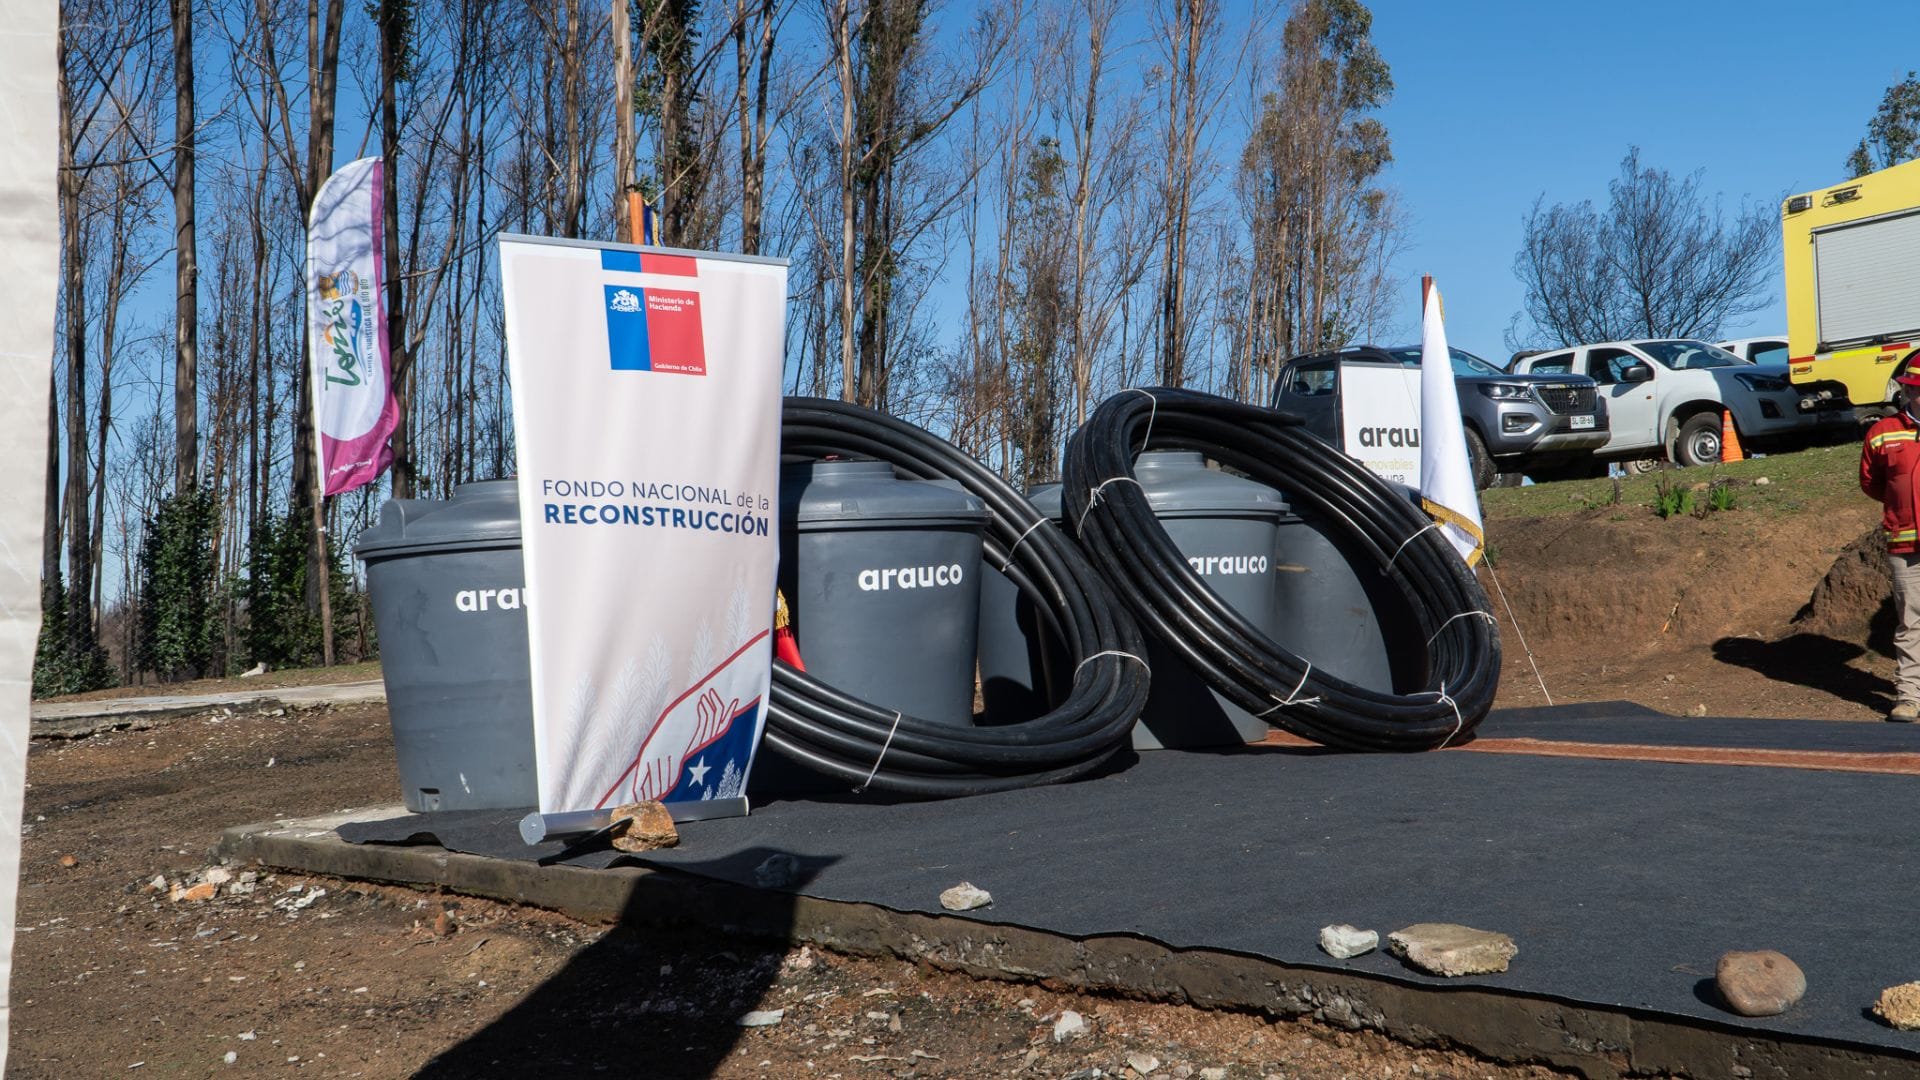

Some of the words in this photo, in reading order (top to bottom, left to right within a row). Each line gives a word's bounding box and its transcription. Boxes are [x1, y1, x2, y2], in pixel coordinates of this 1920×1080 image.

[648, 295, 685, 305] Ministerio
[685, 298, 695, 306] de
[649, 302, 682, 312] Hacienda
[1362, 458, 1415, 471] enovables
[543, 479, 625, 498] FONDO
[632, 481, 732, 506] NACIONAL
[736, 491, 753, 509] de
[757, 494, 770, 511] la
[544, 503, 769, 537] RECONSTRUCCIÓN
[1188, 555, 1268, 575] arauco
[858, 563, 963, 592] arauco
